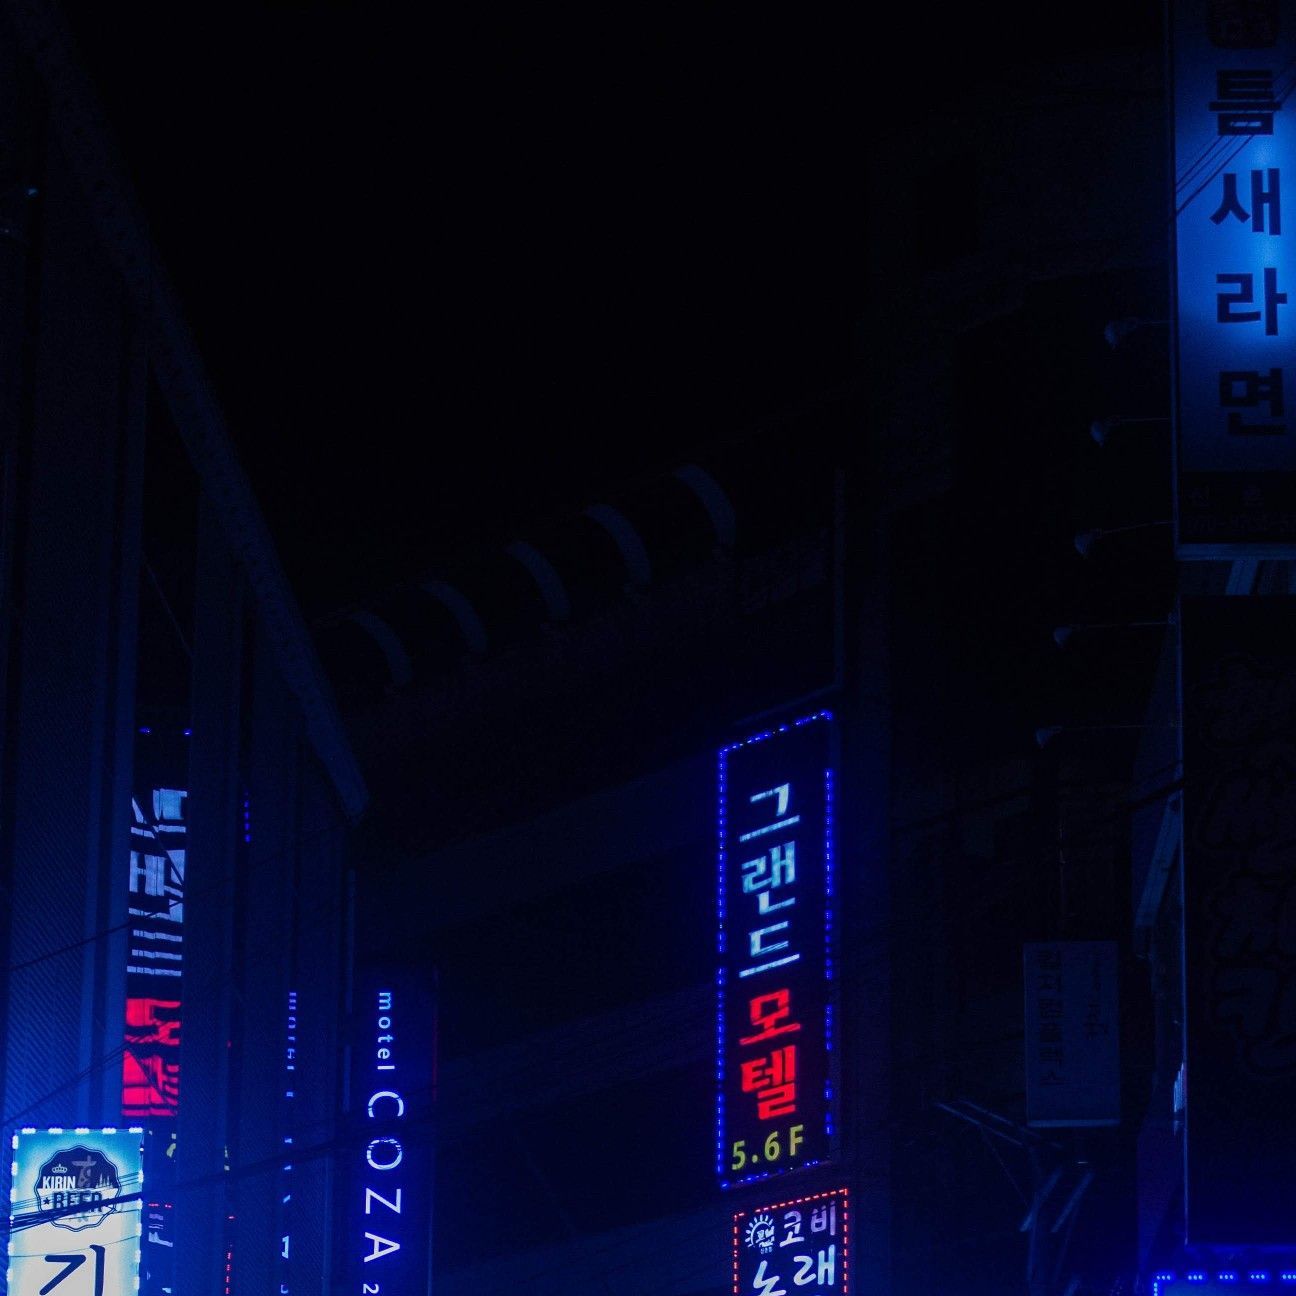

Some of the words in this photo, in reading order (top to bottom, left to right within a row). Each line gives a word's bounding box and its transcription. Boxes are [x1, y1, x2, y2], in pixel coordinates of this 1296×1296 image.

[1208, 69, 1287, 437] 틈새라면
[738, 782, 801, 978] 그랜드
[377, 991, 395, 1070] motel
[739, 987, 802, 1121] 모텔
[42, 1175, 76, 1189] KIRIN
[364, 1090, 405, 1263] COZA
[779, 1200, 837, 1248] 코비
